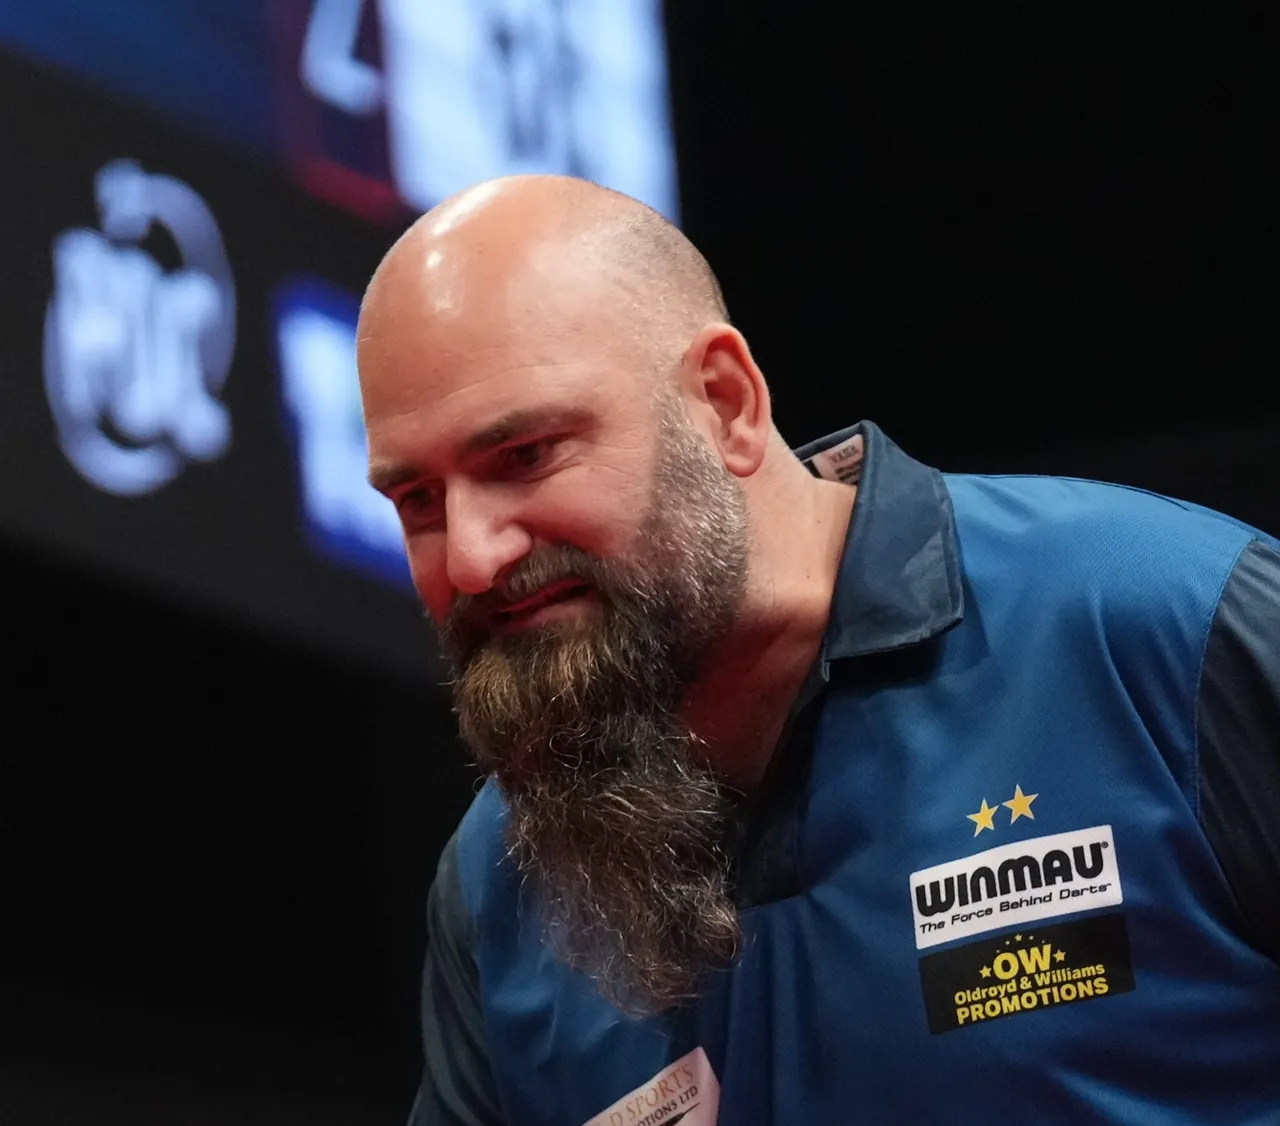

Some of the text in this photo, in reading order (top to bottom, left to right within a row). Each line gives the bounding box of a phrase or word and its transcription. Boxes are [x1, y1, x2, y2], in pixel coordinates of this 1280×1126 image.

[920, 921, 945, 935] The
[951, 907, 993, 925] Force
[999, 892, 1053, 912] Behind
[992, 944, 1052, 980] OW
[954, 963, 1106, 1005] Oldroyd & Williams
[956, 977, 1109, 1025] PROMOTIONS
[626, 1063, 694, 1121] SPORTS
[679, 1085, 698, 1105] LTD
